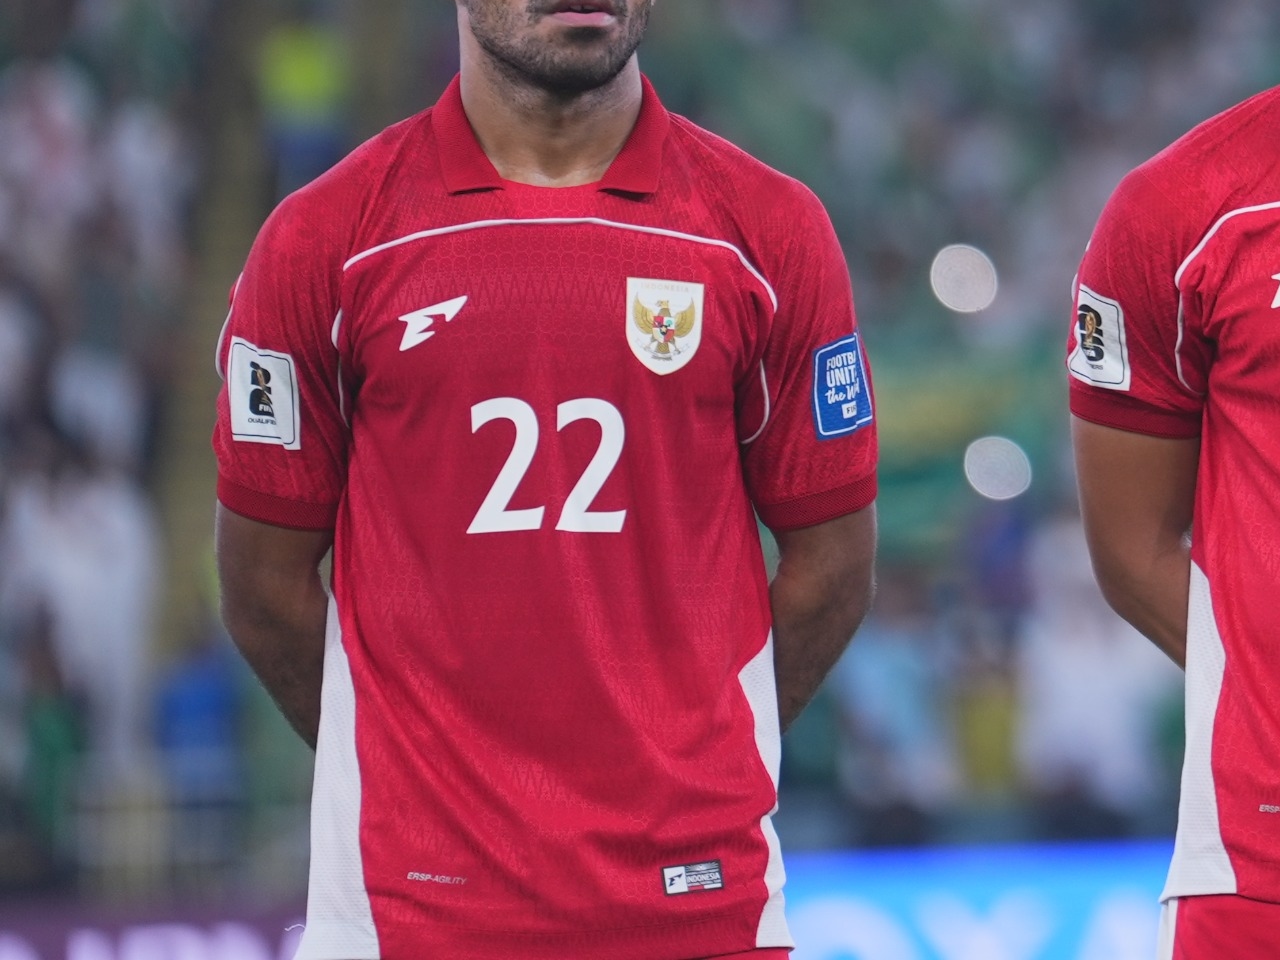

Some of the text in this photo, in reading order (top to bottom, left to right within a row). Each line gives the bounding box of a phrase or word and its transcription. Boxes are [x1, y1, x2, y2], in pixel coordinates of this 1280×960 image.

[826, 364, 857, 388] UNIT
[824, 387, 847, 404] the
[467, 397, 627, 534] 22
[406, 871, 467, 885] ERSP-AGILITY
[686, 872, 721, 884] INDONESIA
